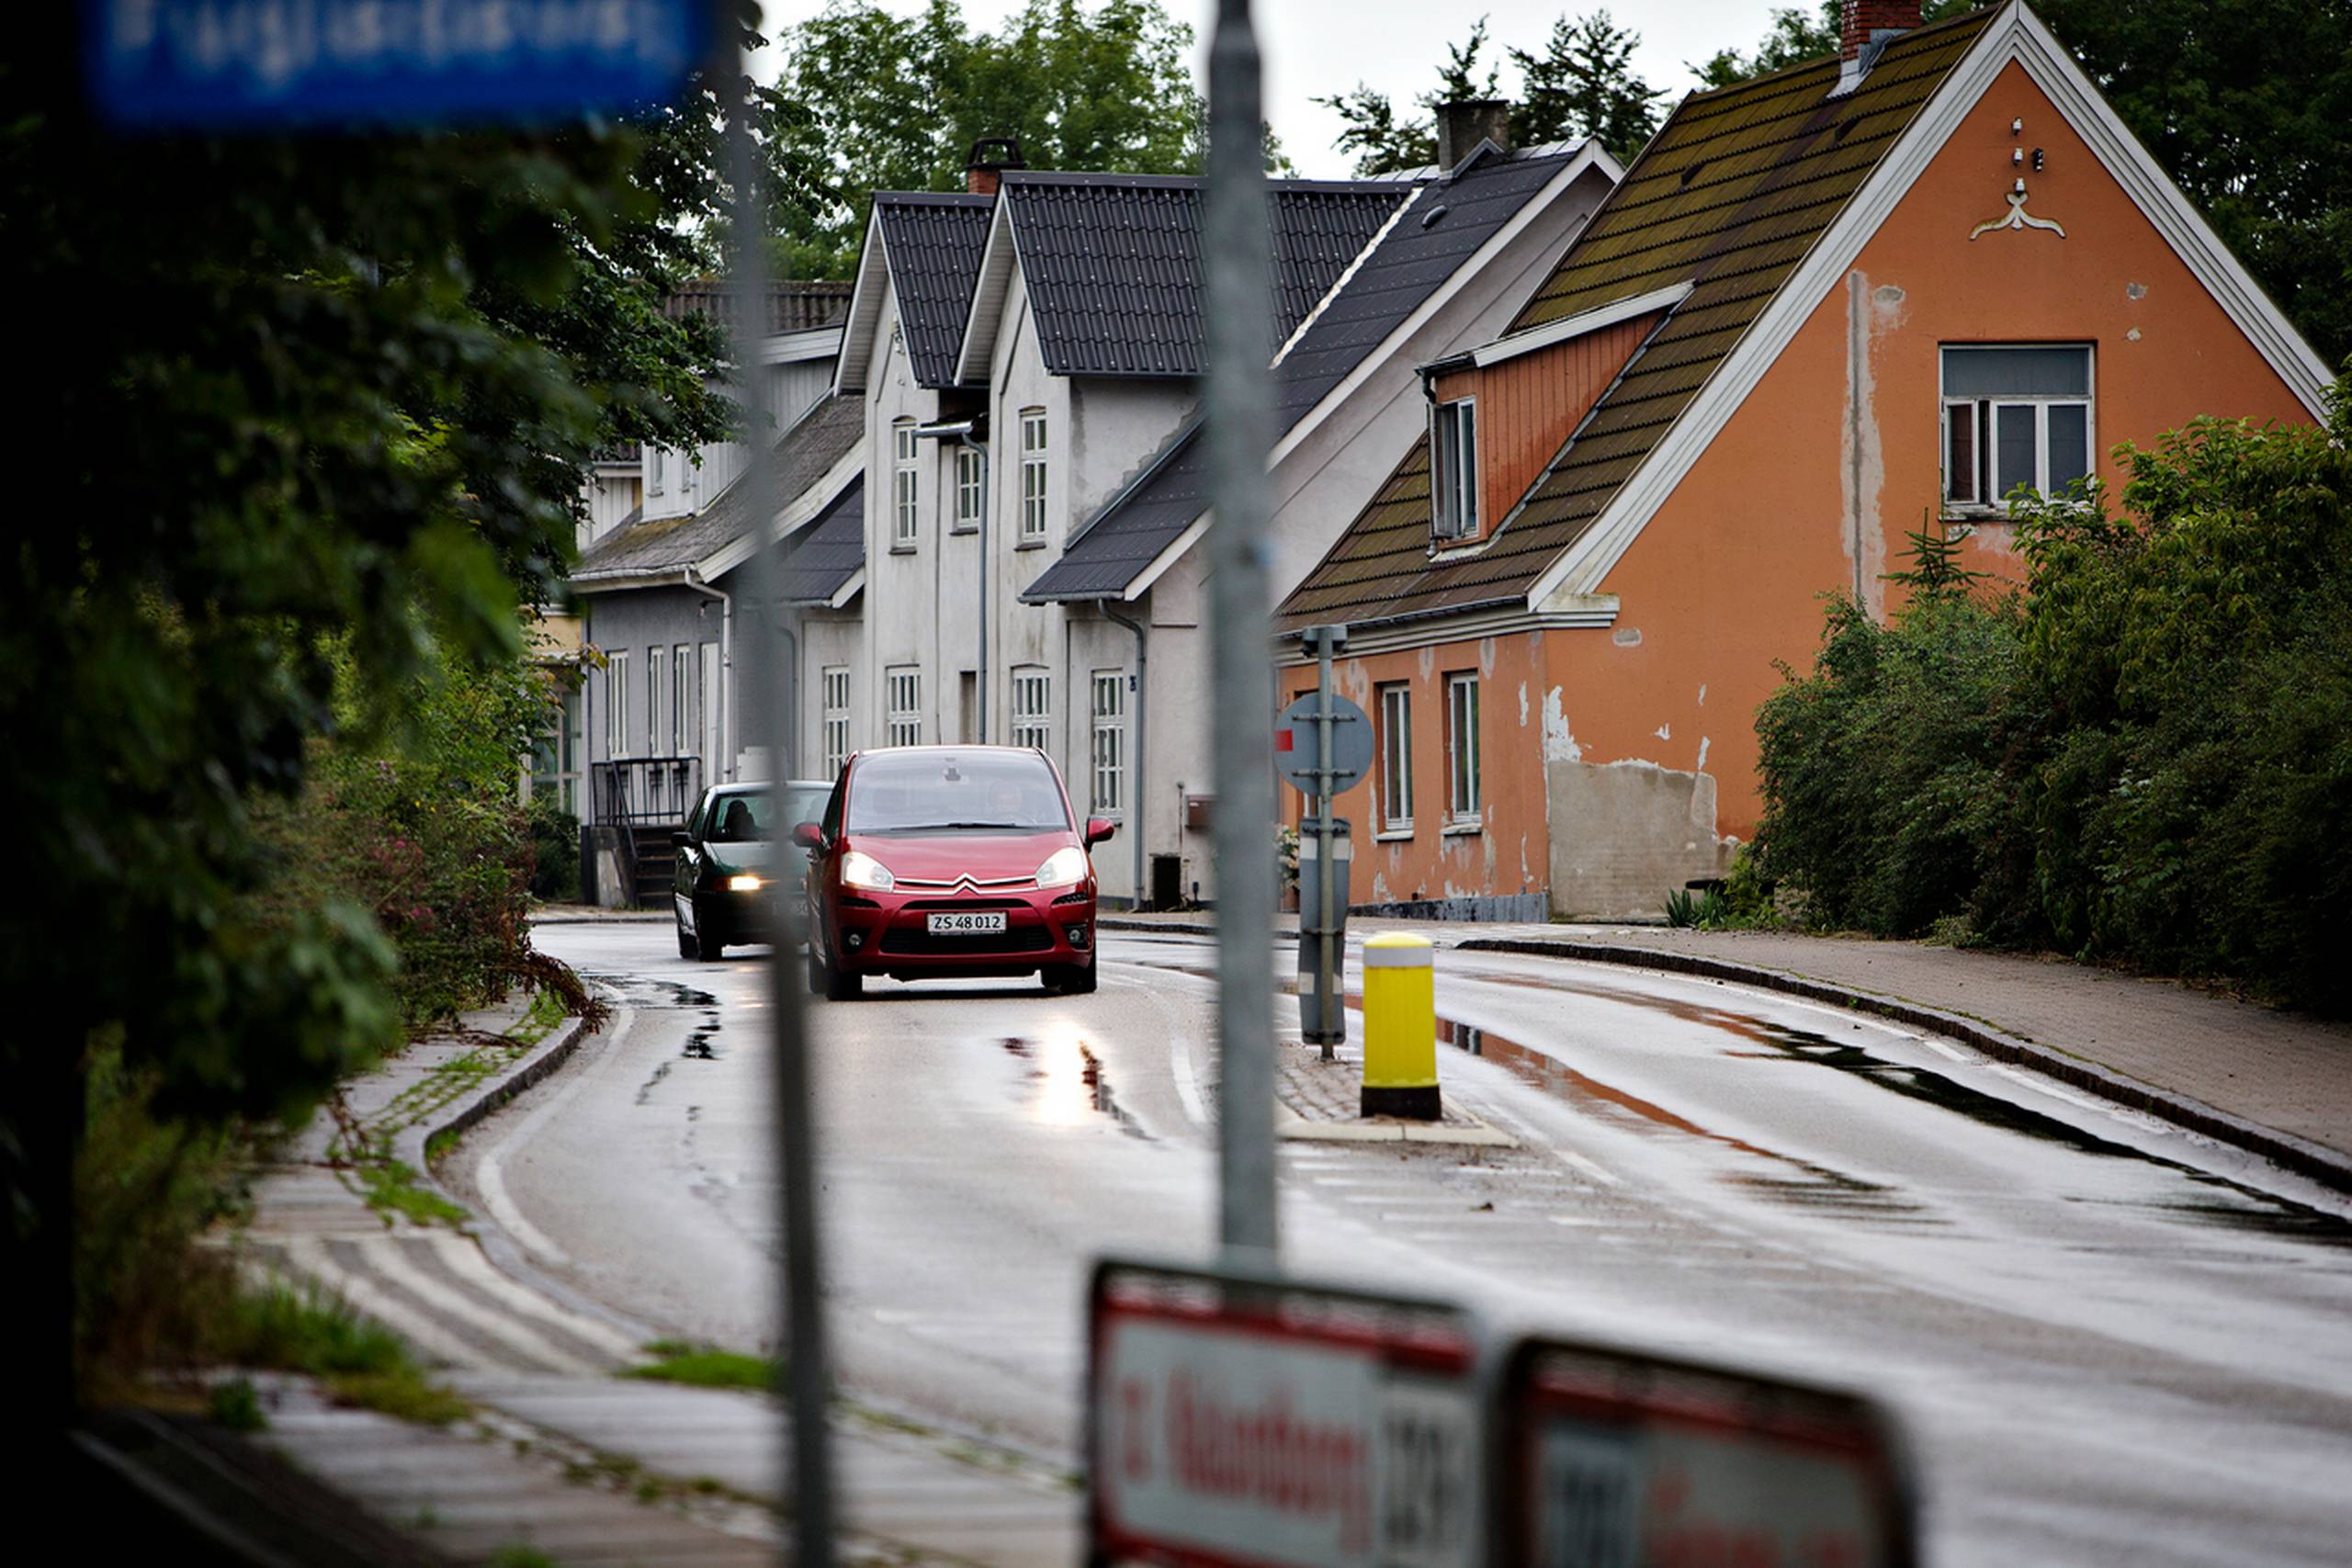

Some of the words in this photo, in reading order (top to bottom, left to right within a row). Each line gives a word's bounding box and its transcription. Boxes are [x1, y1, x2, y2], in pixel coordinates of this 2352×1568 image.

[934, 916, 953, 929] ZS
[956, 916, 972, 929] 48
[975, 916, 1001, 929] 012
